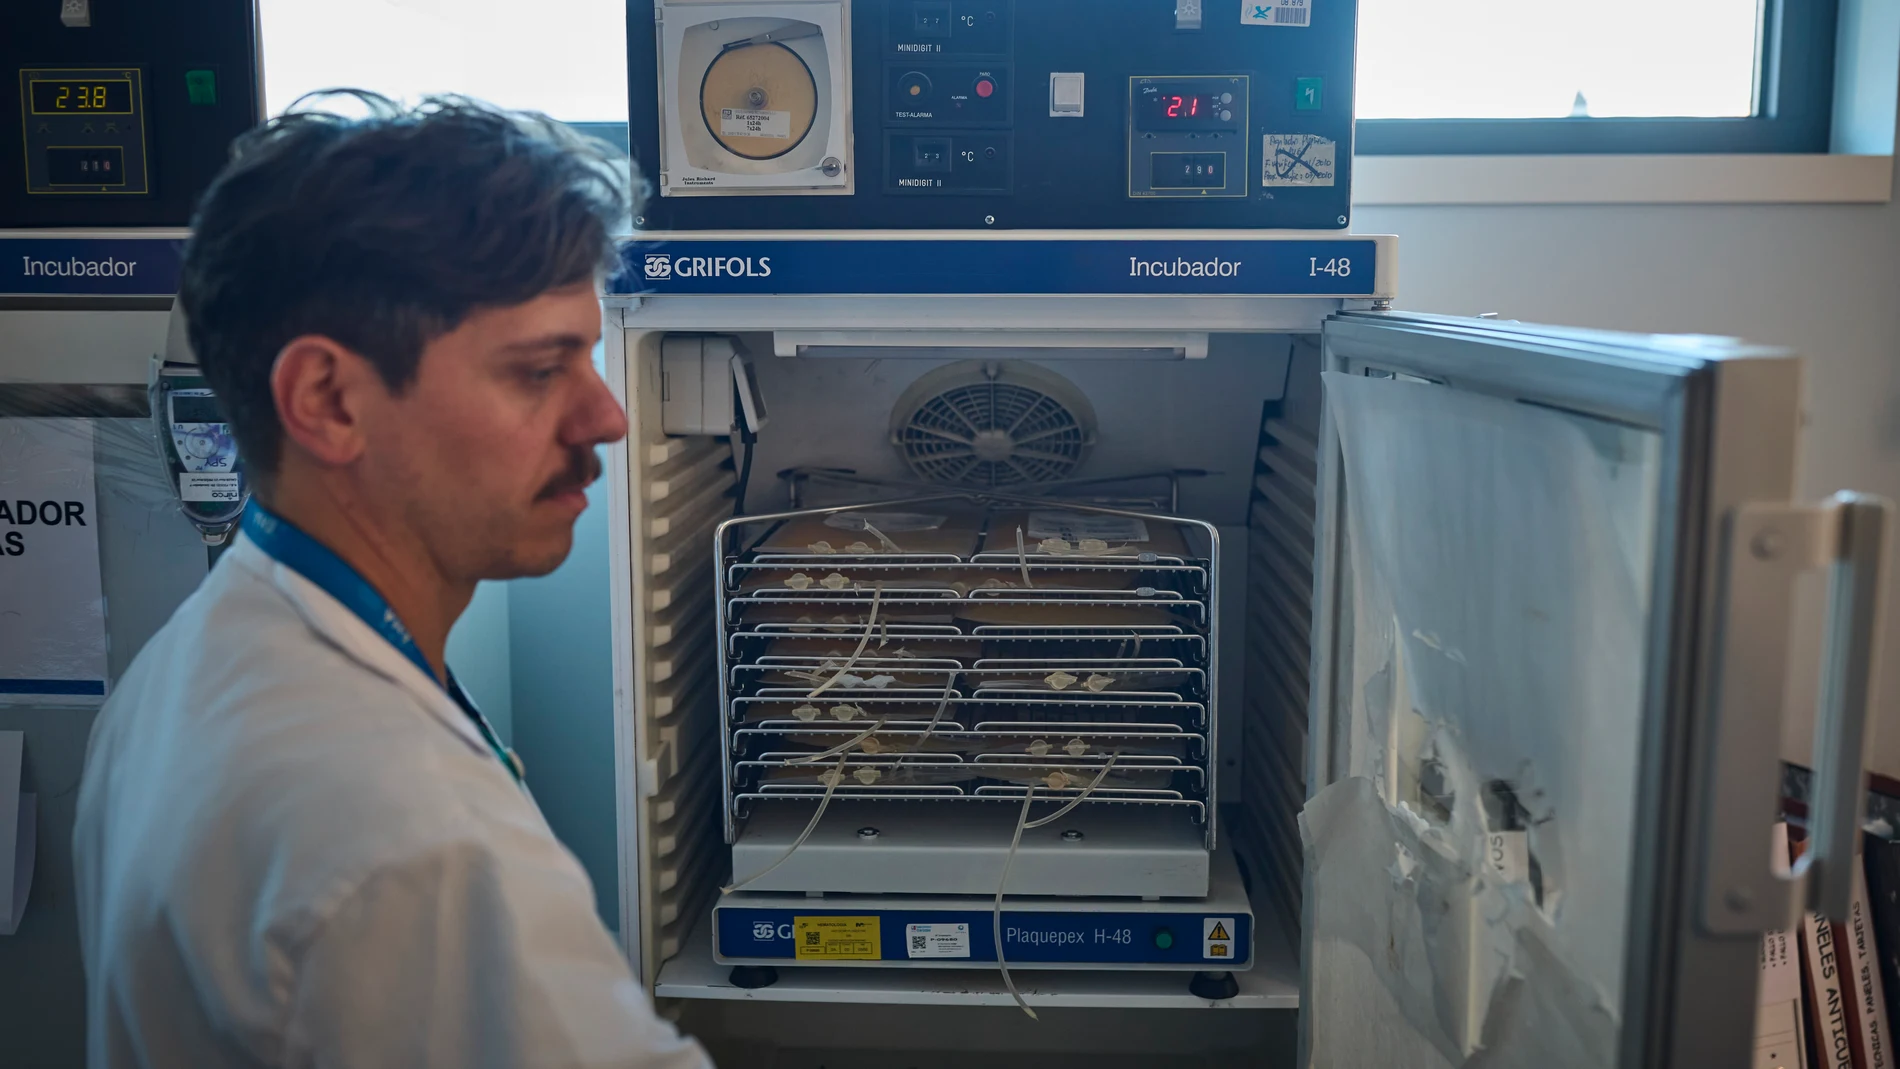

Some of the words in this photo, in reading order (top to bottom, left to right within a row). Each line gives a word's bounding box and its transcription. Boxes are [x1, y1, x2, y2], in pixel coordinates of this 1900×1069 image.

[960, 15, 974, 27] °C
[897, 44, 932, 52] MINIDIGIT
[55, 86, 107, 109] 23.8
[961, 150, 974, 162] °C
[898, 178, 933, 187] MINIDIGIT
[22, 256, 137, 277] Incubador
[674, 256, 772, 278] GRIFOLS
[1129, 256, 1242, 277] Incubador
[1309, 256, 1351, 277] I-48
[204, 457, 227, 467] SPY
[0, 500, 87, 526] ADOR
[0, 531, 25, 557] S
[1006, 927, 1085, 946] Plaquepex
[1094, 928, 1132, 944] H-48
[1852, 901, 1867, 960] TARJETAS
[1869, 1019, 1884, 1069] ECNICAS
